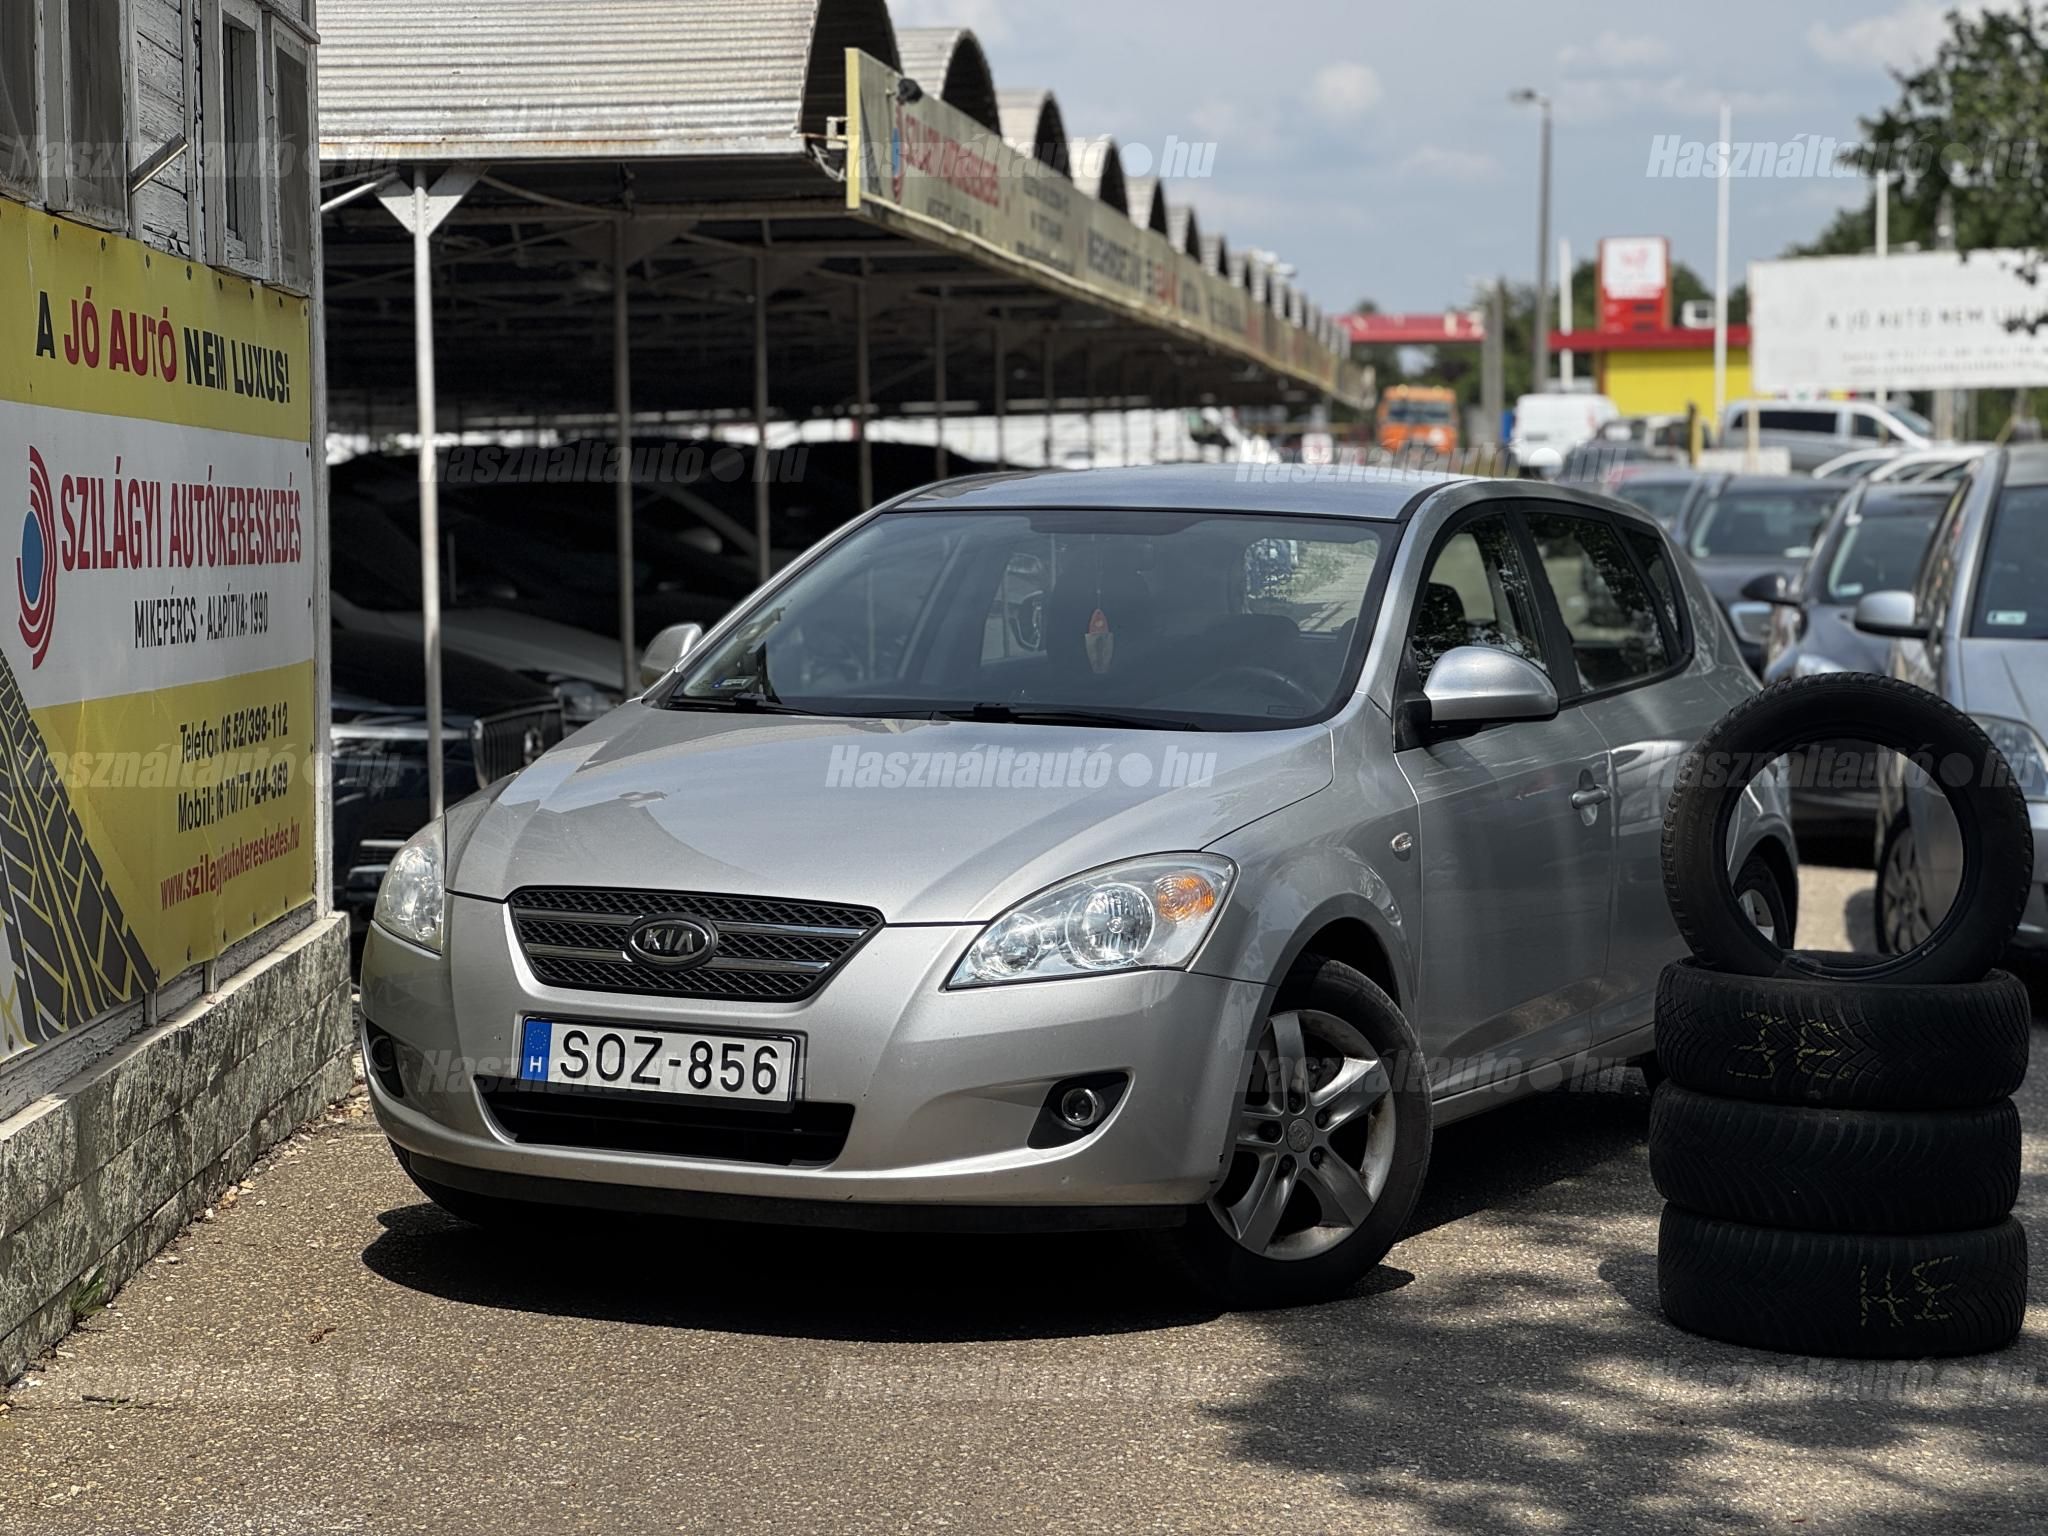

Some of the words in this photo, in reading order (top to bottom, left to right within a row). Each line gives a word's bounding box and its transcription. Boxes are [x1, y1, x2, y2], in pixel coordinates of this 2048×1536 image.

[36, 291, 56, 359] A
[64, 286, 100, 368] JÓ
[109, 306, 177, 382] AUTÓ
[184, 327, 228, 392] NEM
[230, 339, 291, 403] LUXUS!
[61, 456, 162, 572] SZILÁGYI
[169, 464, 301, 568] AUTÓKERESKEDÉS
[134, 585, 197, 649] MIKEPÉRCS
[207, 583, 248, 641] ALAPÍTVA:
[250, 591, 268, 635] 1990
[233, 701, 288, 749] 52/398-112
[178, 786, 214, 832] Mobil:
[643, 928, 694, 953] KIA
[529, 1055, 542, 1073] H
[560, 1029, 779, 1095] SOZ-856
